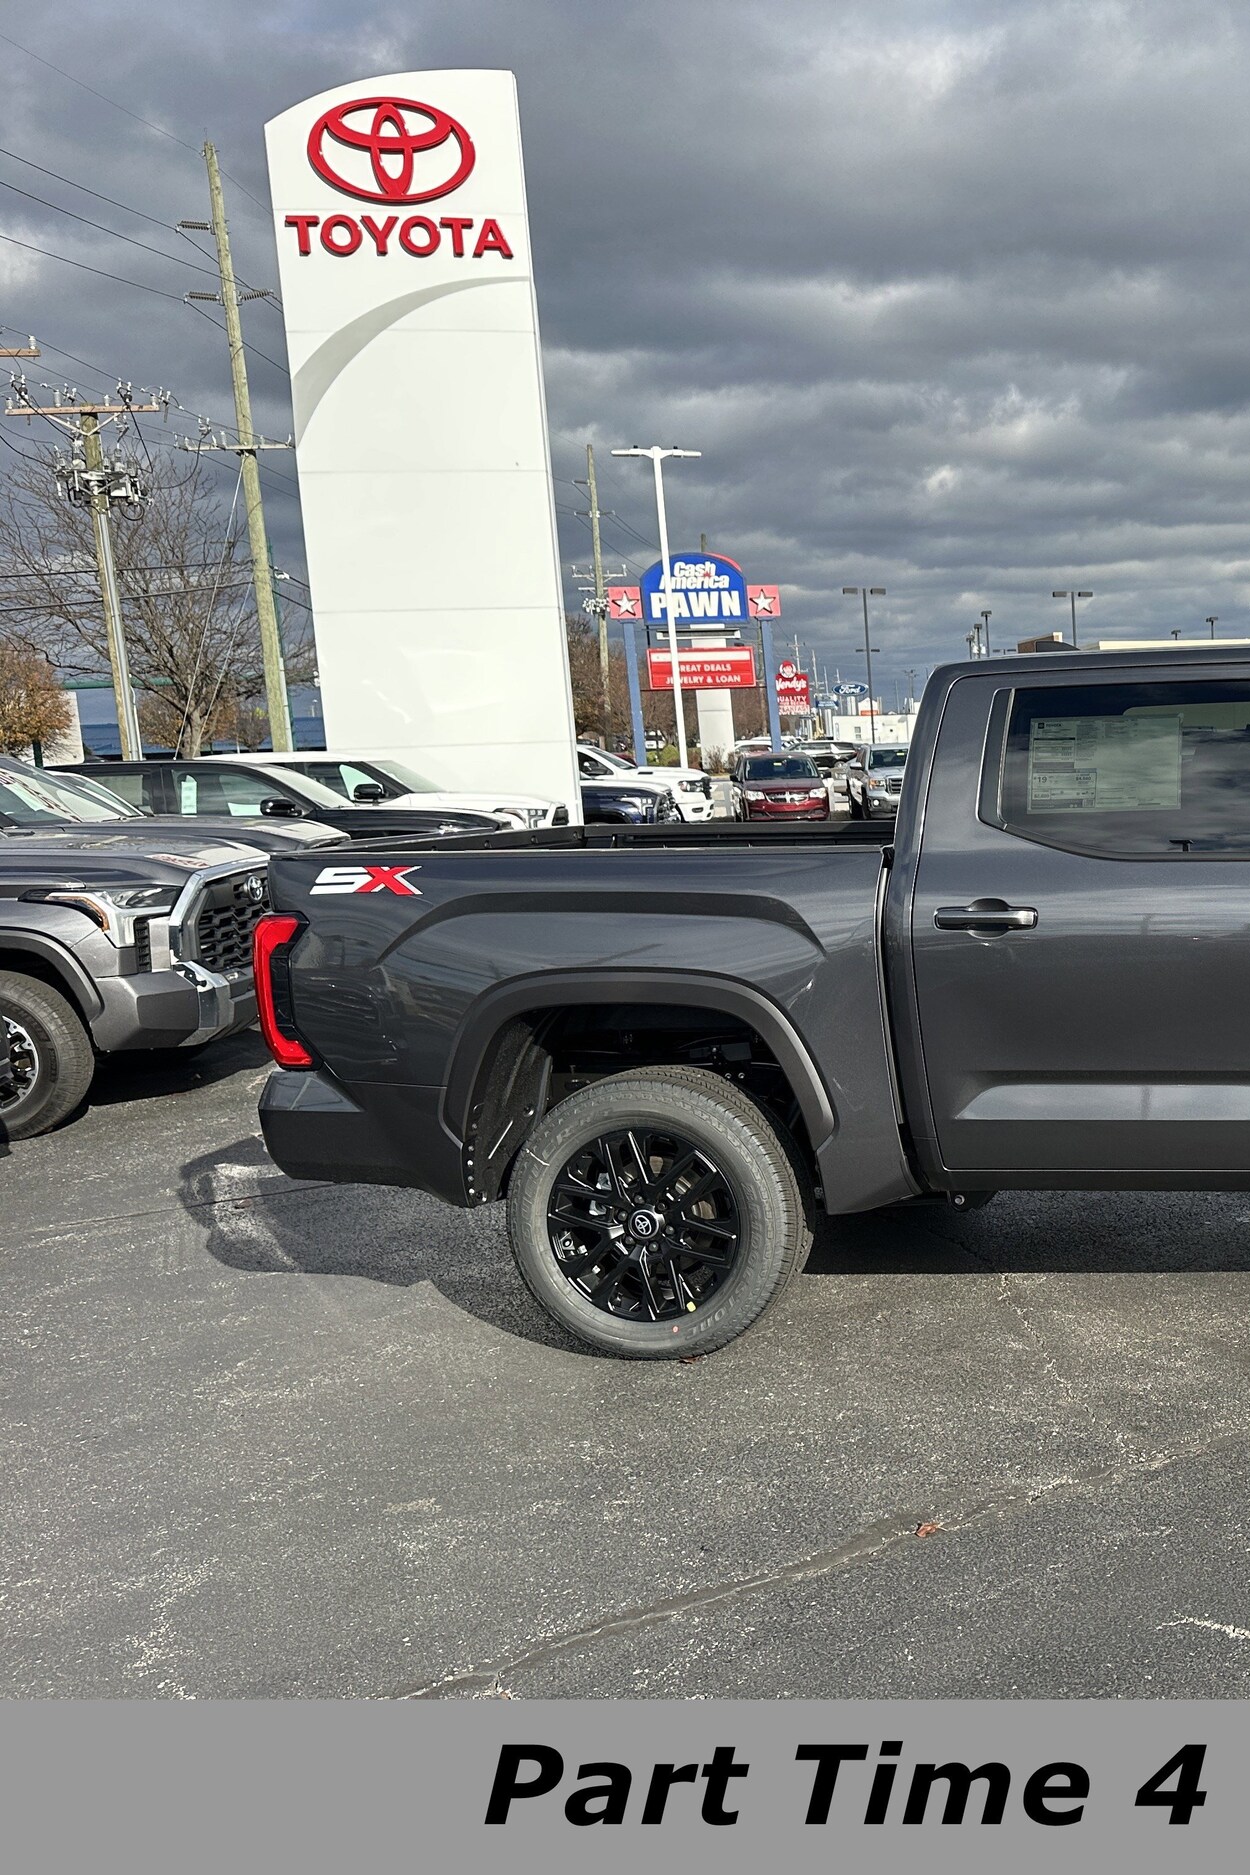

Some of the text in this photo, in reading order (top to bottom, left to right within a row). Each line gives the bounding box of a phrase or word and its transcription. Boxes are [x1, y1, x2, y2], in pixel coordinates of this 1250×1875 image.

[285, 214, 513, 258] TOYOTA
[673, 561, 716, 577] Cash
[650, 591, 741, 618] PAWN
[679, 663, 732, 673] REAT DEALS
[715, 675, 741, 683] LOAN
[839, 684, 861, 694] Ford
[777, 695, 807, 703] UALITY
[309, 866, 423, 896] SX
